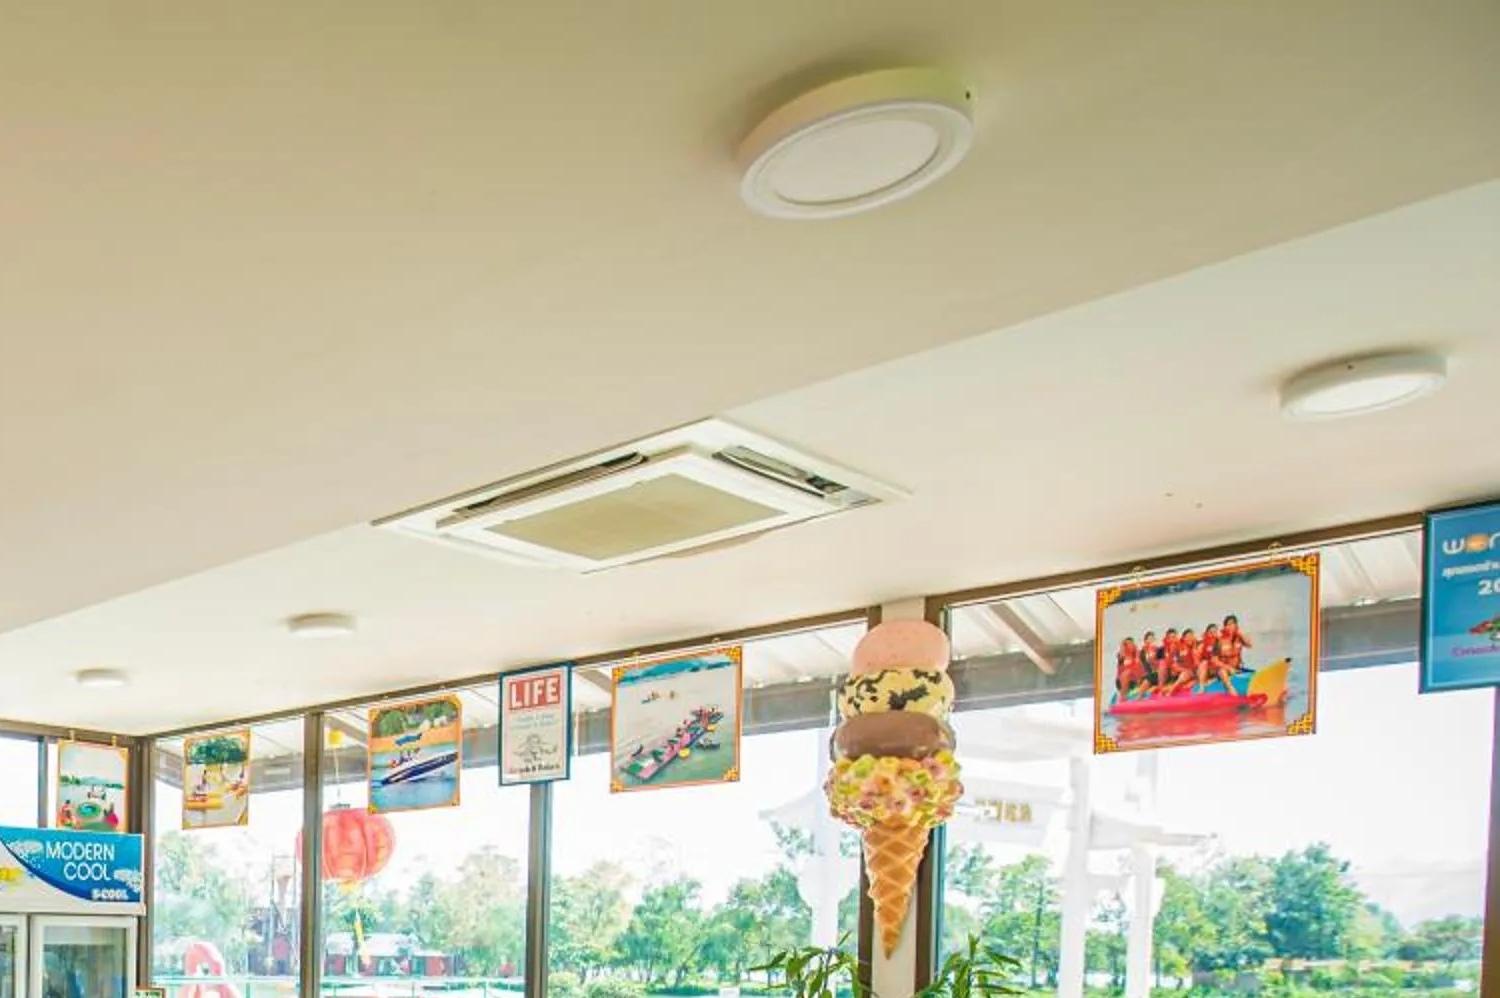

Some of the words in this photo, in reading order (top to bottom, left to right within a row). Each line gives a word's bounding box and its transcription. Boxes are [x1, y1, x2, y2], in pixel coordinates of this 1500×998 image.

[511, 677, 559, 708] LIFE
[45, 841, 115, 861] MODERN
[63, 862, 111, 880] COOL
